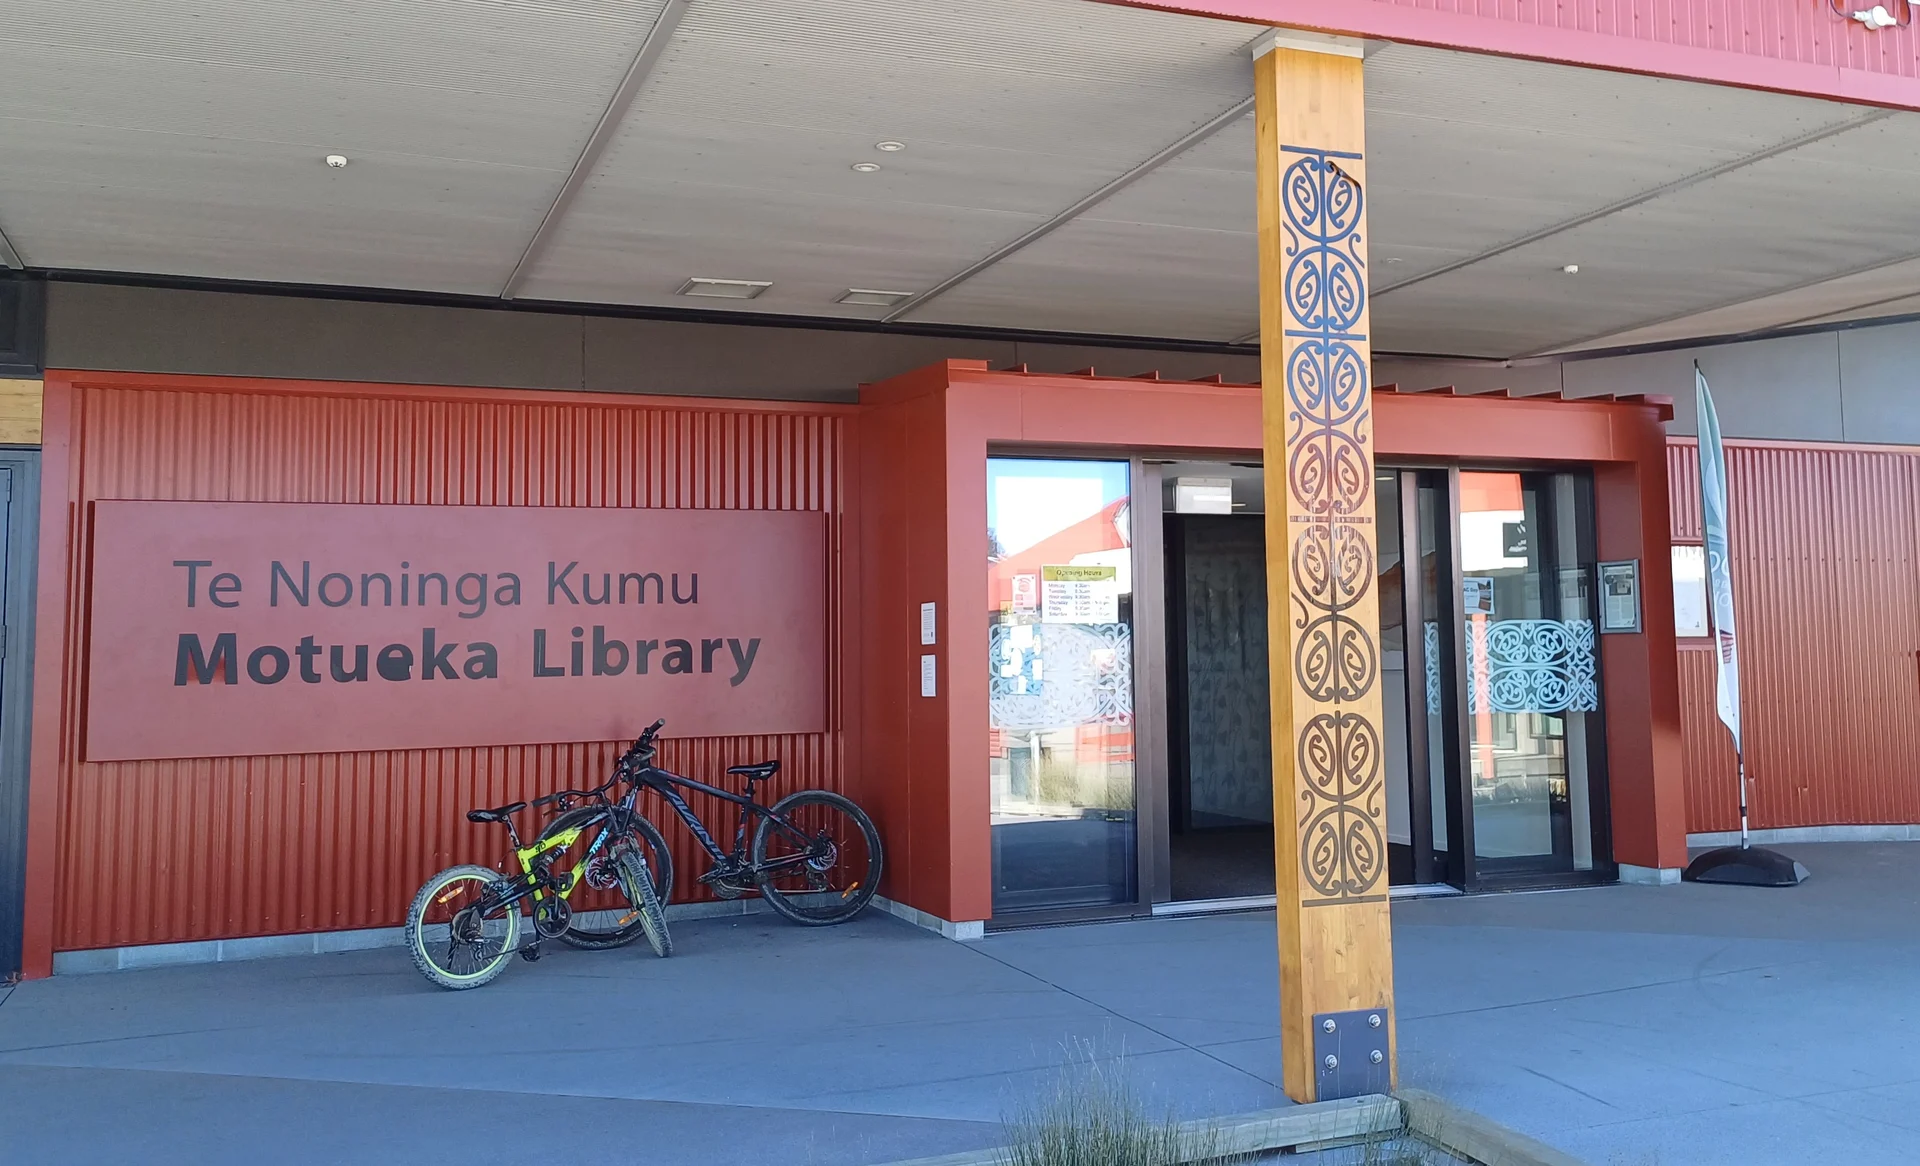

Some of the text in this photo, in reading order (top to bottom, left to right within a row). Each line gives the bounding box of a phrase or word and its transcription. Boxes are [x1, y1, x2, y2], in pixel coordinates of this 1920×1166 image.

[173, 559, 700, 619] Te Noninga Kumu
[174, 625, 761, 687] Motueka Library
[588, 826, 609, 855] TRAX
